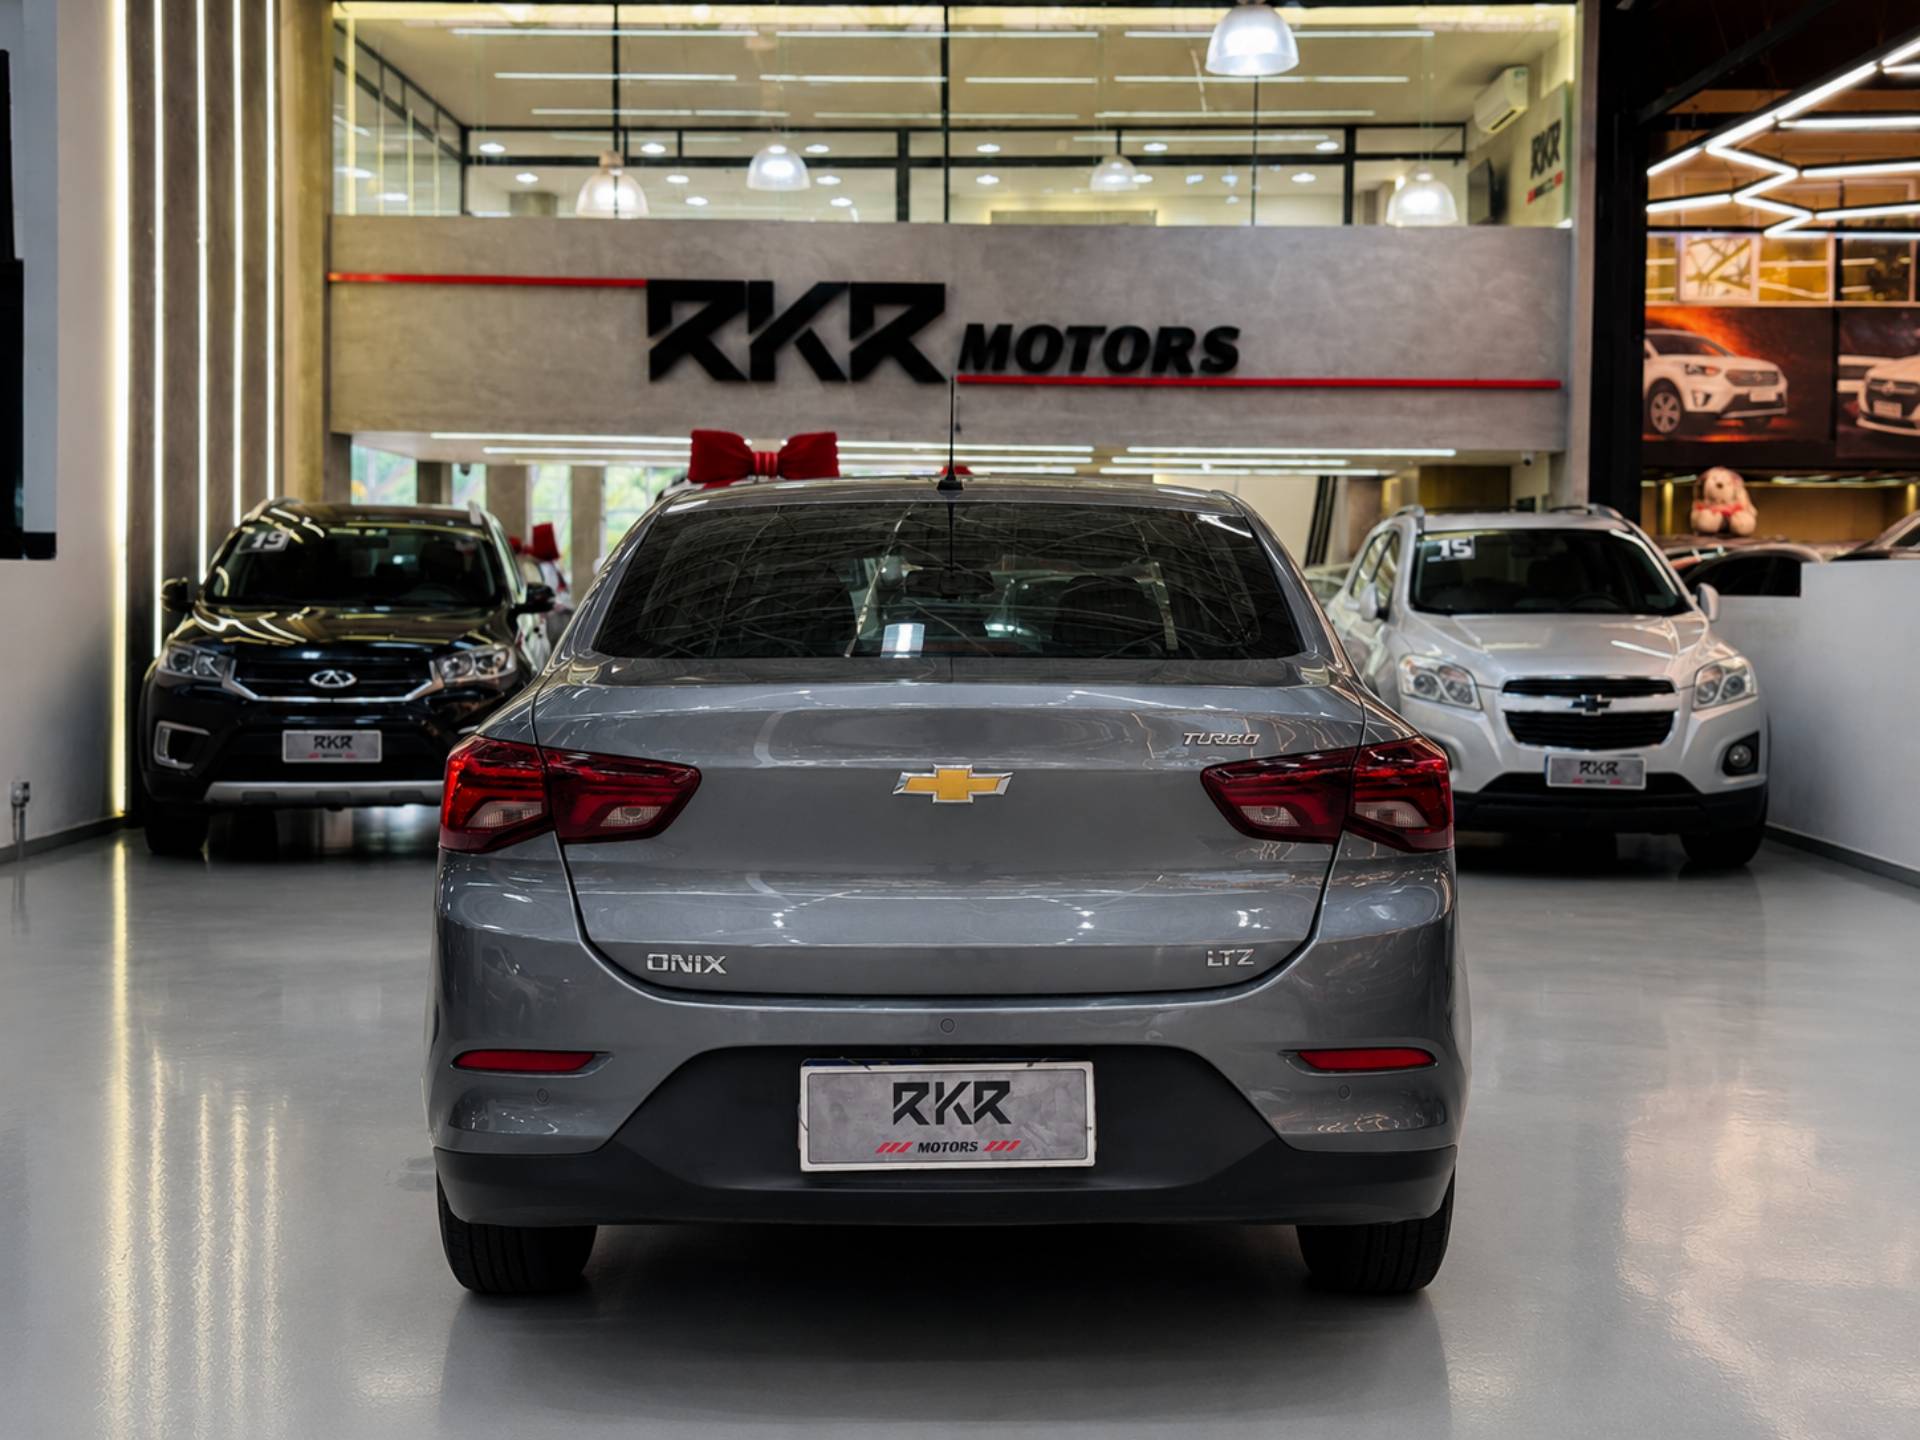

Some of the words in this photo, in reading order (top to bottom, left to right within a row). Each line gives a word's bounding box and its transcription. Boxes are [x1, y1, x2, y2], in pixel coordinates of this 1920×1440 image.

[647, 280, 947, 382] RKR
[958, 324, 1240, 374] MOTORS
[251, 531, 288, 550] 19
[1439, 539, 1472, 558] 15
[314, 736, 352, 750] RKR
[1183, 732, 1260, 745] TURBO
[1580, 761, 1618, 776] RKR
[647, 953, 727, 974] ONIX
[1207, 948, 1255, 967] LTZ
[893, 1080, 1012, 1126] RKR
[917, 1141, 979, 1154] MOTORS
